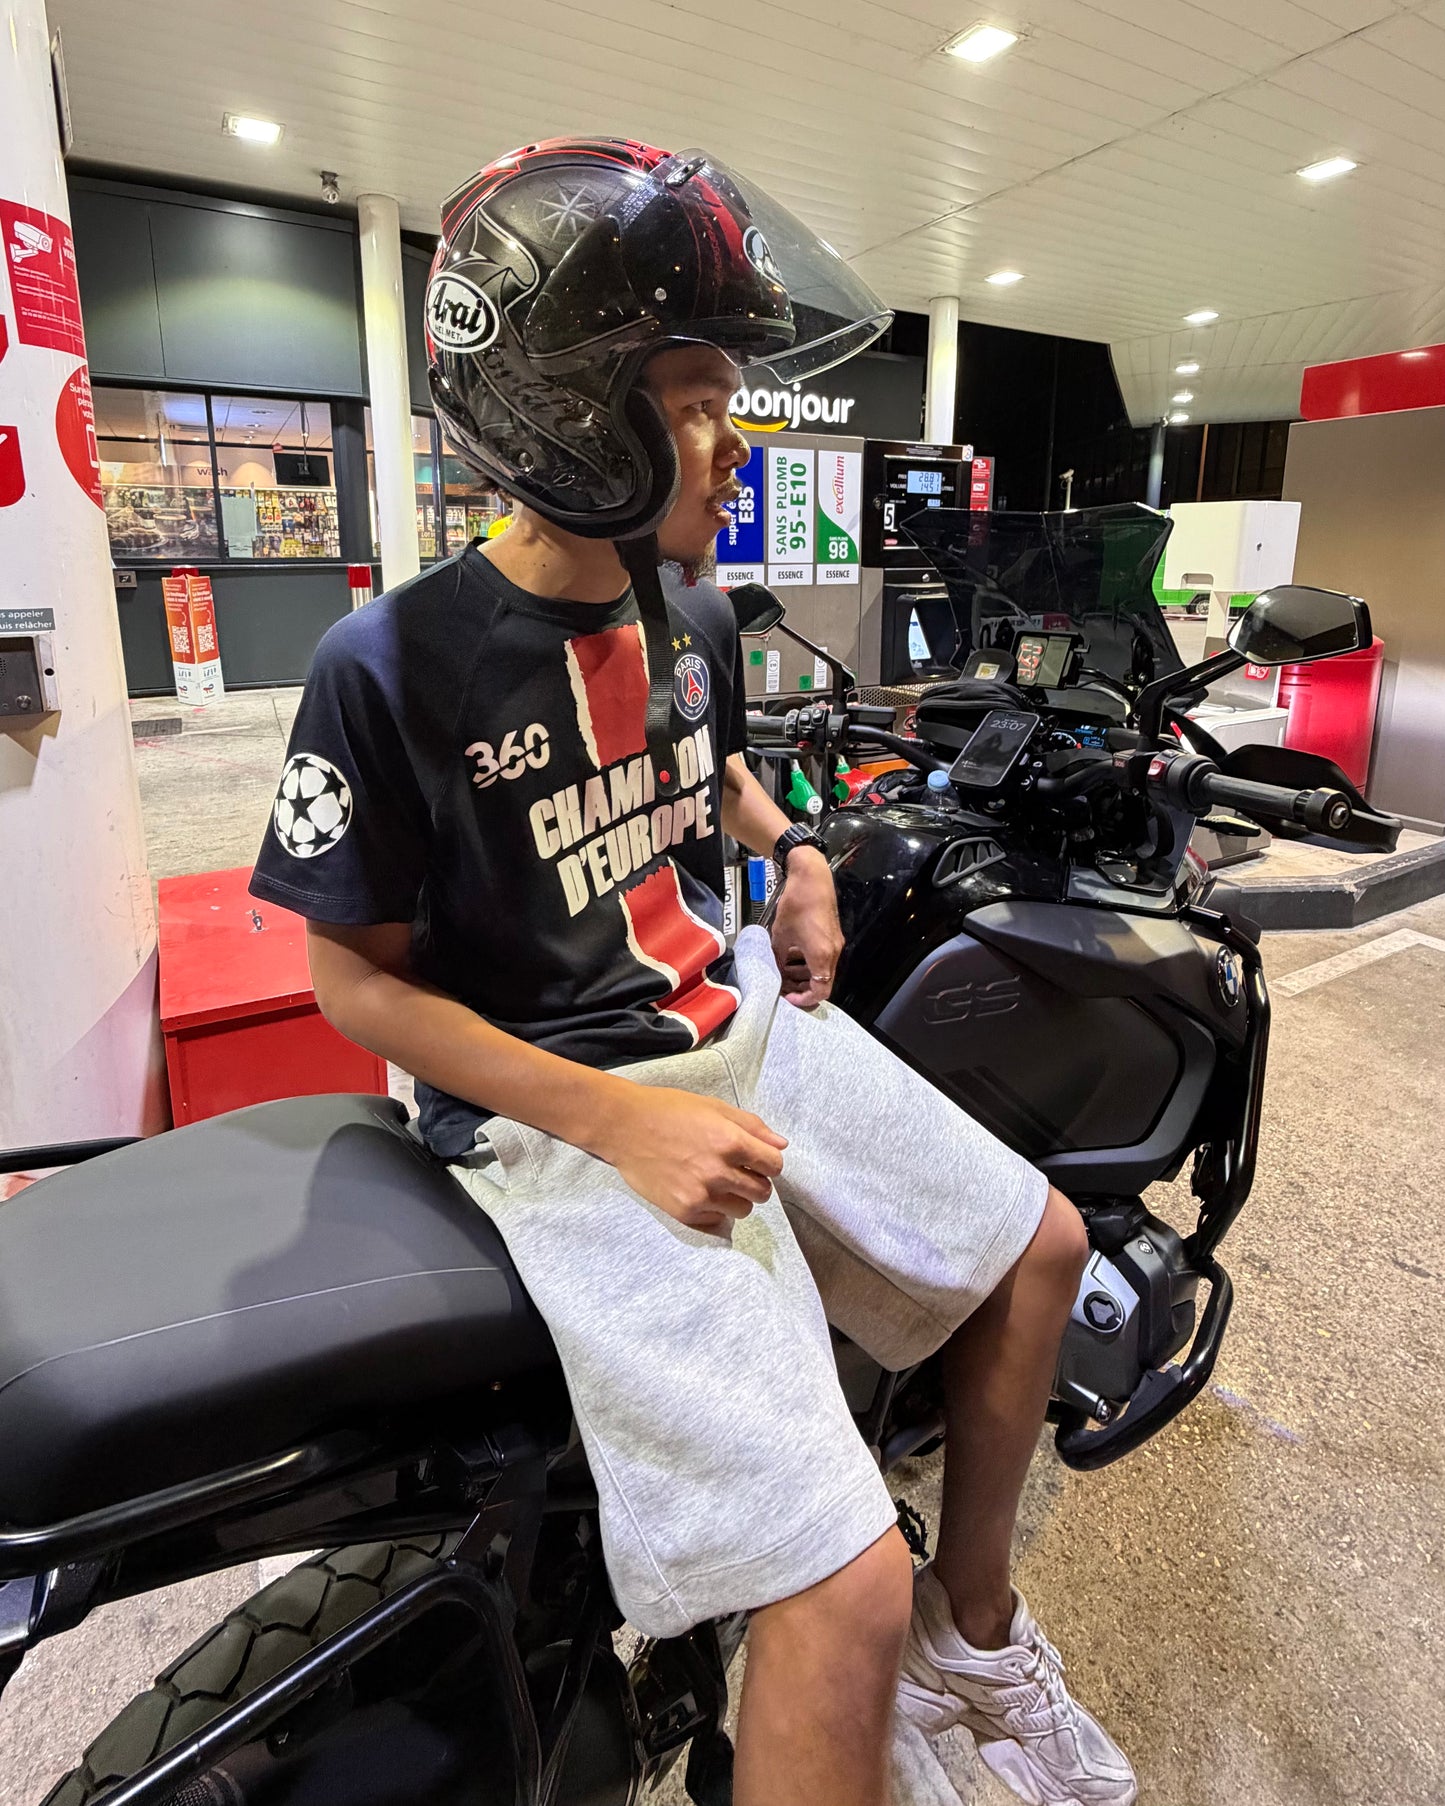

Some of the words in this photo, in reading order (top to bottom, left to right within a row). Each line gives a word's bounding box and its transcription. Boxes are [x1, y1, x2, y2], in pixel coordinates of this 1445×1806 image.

[433, 282, 482, 334] Arai
[729, 382, 855, 428] bonjour
[776, 456, 787, 509] PLOMB
[832, 455, 845, 515] excellium
[738, 486, 755, 524] E85
[789, 463, 807, 550] 95-E10
[885, 506, 893, 527] 5
[729, 514, 739, 546] super
[776, 515, 787, 556] SANS
[828, 541, 849, 560] 98
[727, 571, 755, 581] ESSENCE
[777, 570, 804, 580] ESSENCE
[825, 570, 850, 579] ESSENCE
[8, 611, 44, 619] appeler
[15, 621, 52, 629] relâcher
[676, 657, 702, 678] PARIS
[990, 719, 1027, 731] 23:07
[464, 722, 550, 789] 360
[528, 724, 714, 860] CHAMON
[556, 786, 714, 918] D'EUROPE
[923, 975, 1021, 1024] GS
